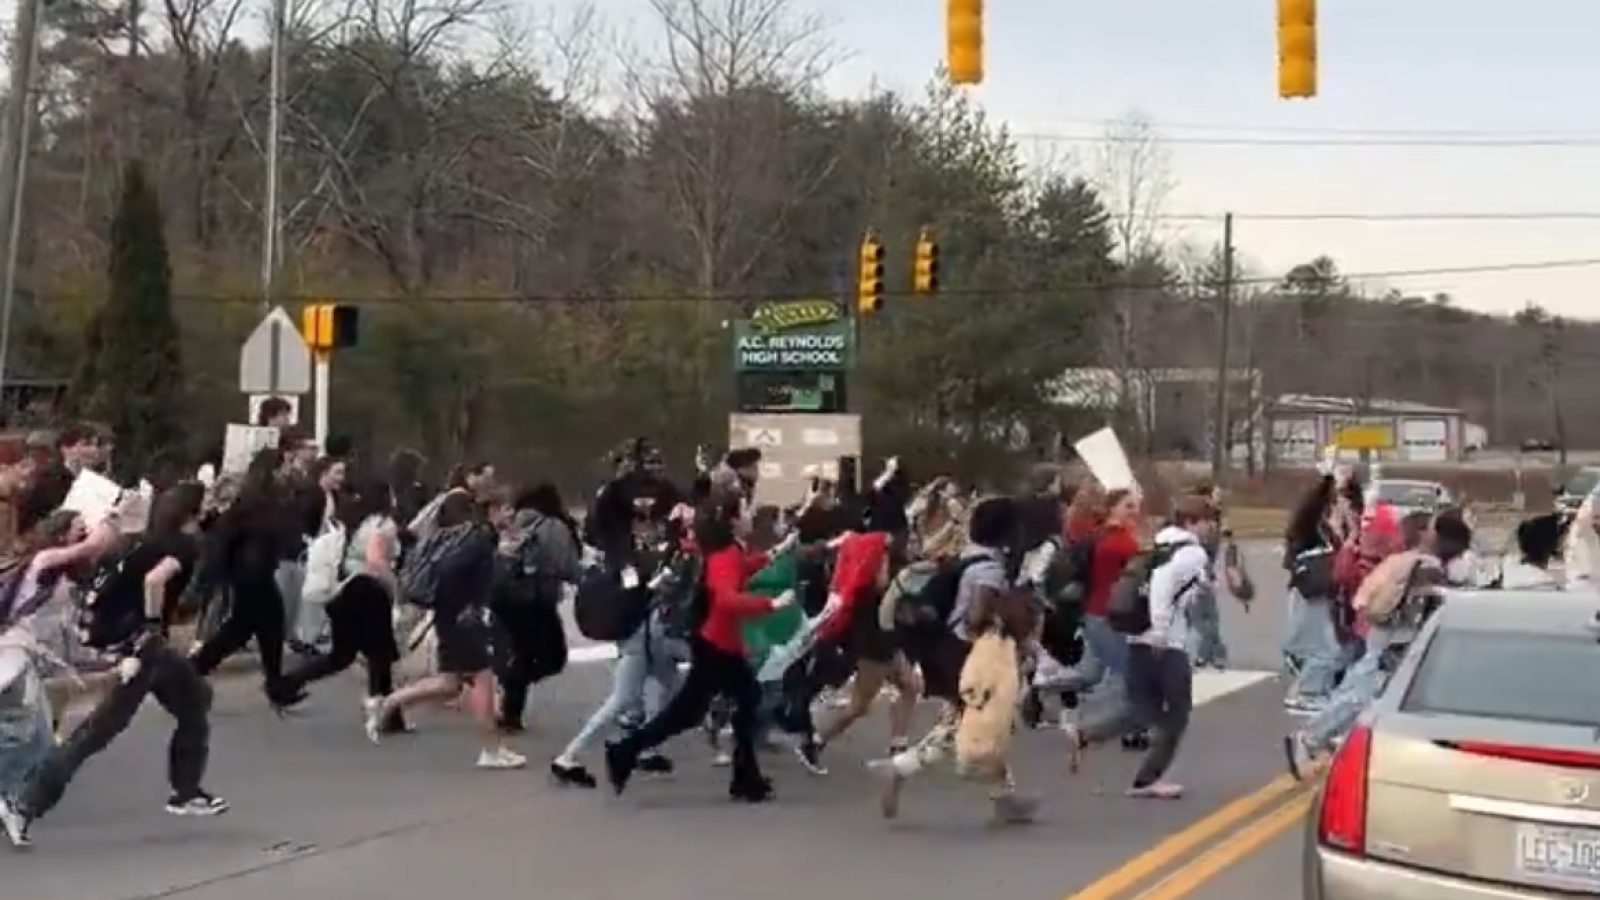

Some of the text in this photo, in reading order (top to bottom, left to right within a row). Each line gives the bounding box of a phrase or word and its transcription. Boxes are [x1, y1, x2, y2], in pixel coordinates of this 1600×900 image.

[737, 335, 844, 349] A.C. REYNOLDS
[742, 351, 841, 364] HIGH SCHOOL
